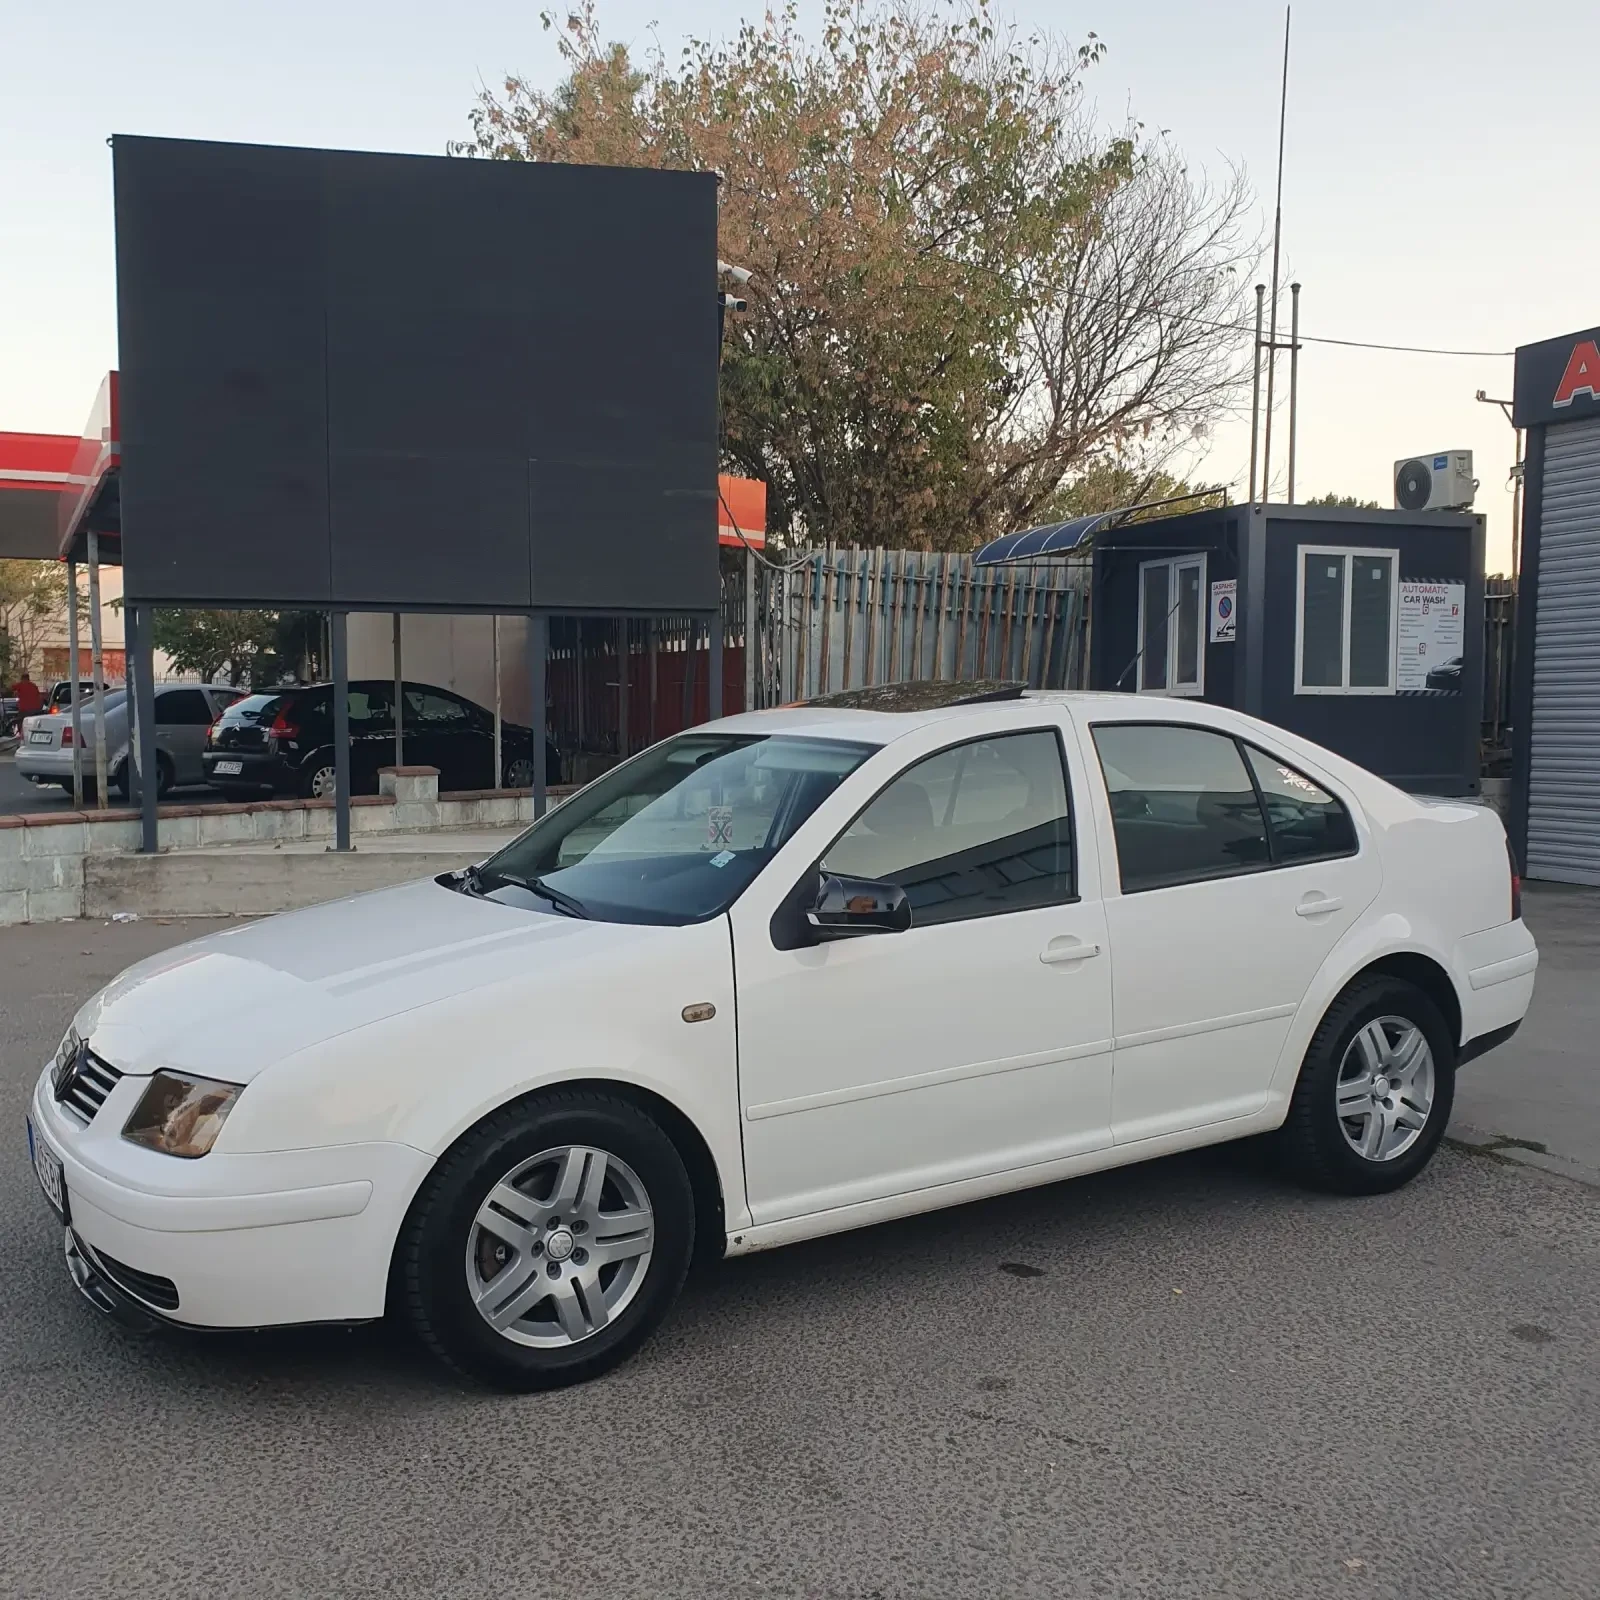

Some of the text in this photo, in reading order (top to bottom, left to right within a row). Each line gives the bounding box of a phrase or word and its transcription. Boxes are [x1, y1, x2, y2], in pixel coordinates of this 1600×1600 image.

[1402, 586, 1448, 594] AUTOMATIC
[1404, 596, 1446, 604] CAR WASH
